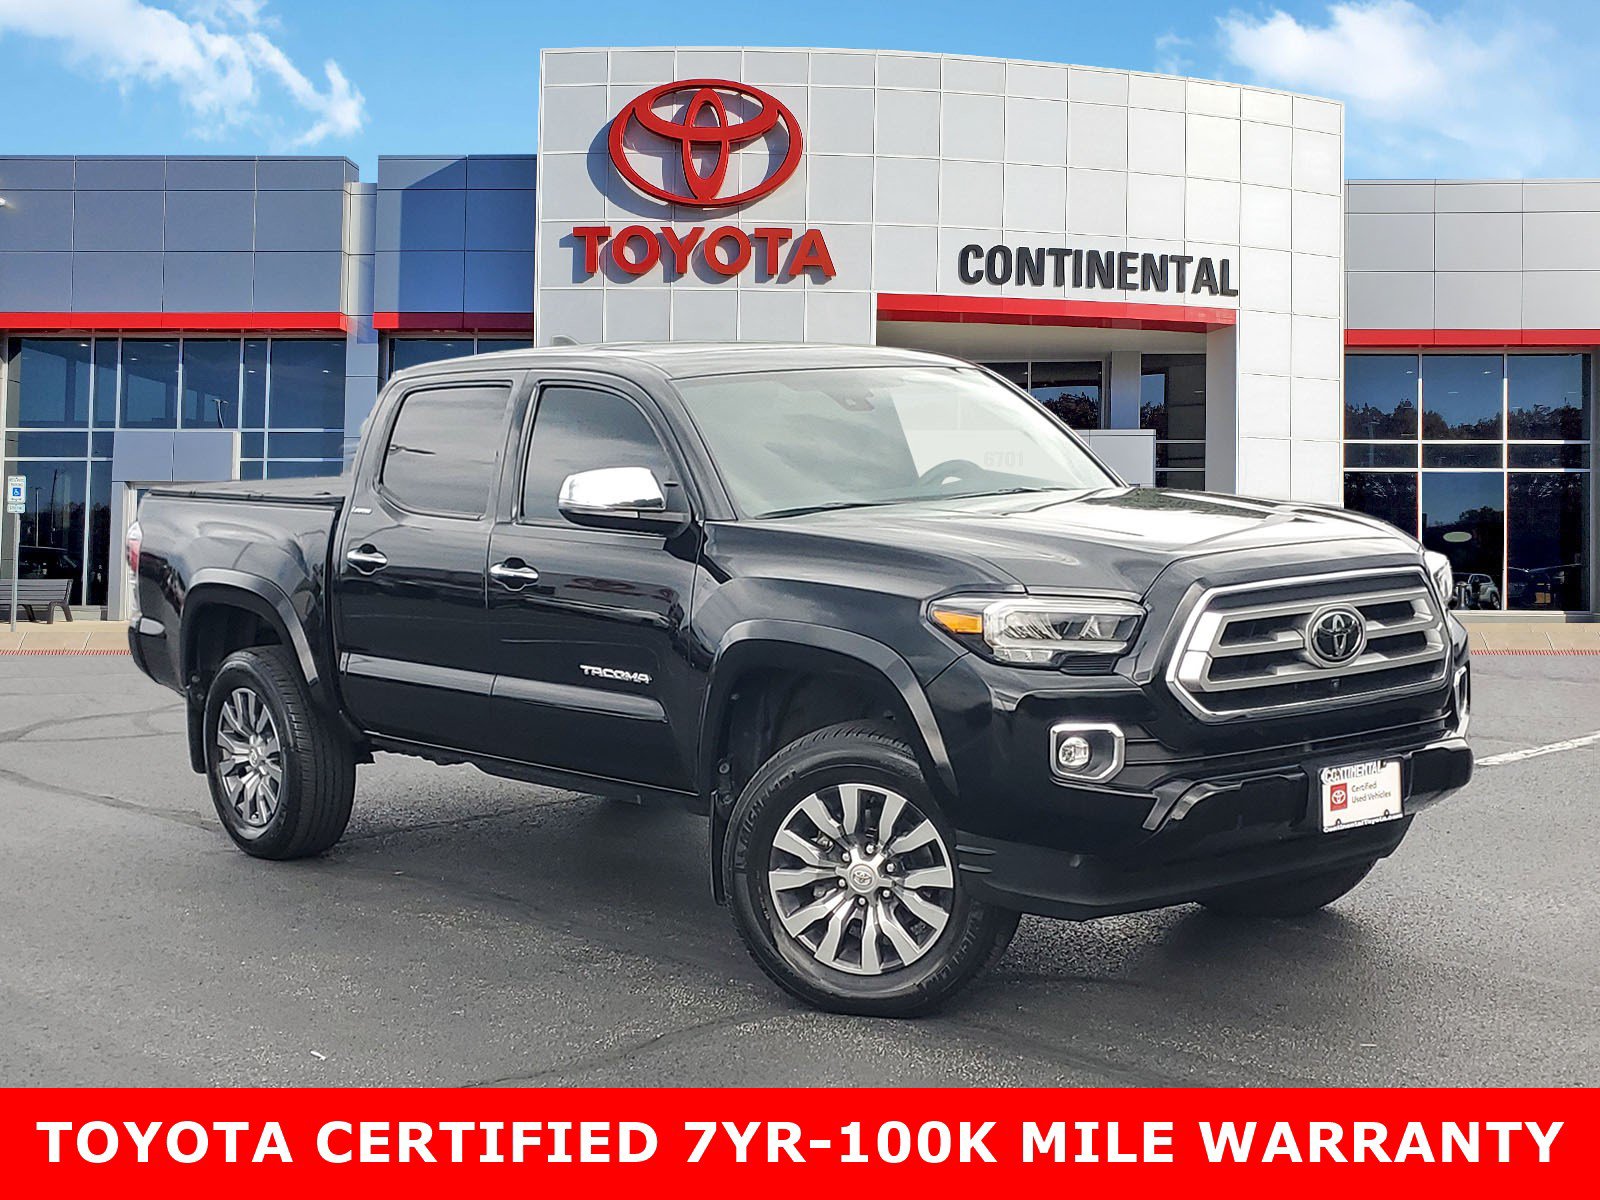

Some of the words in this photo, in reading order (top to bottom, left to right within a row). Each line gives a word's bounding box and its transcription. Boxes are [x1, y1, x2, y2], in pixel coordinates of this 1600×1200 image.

[573, 225, 836, 277] TOYOTA
[959, 244, 1239, 297] CONTINENTAL
[984, 451, 1024, 467] 6701
[579, 664, 652, 684] TACOMA
[1321, 760, 1384, 785] CONTINENTAL
[1351, 781, 1377, 793] Certified
[1351, 794, 1367, 804] Used
[1368, 790, 1392, 801] Vehicles
